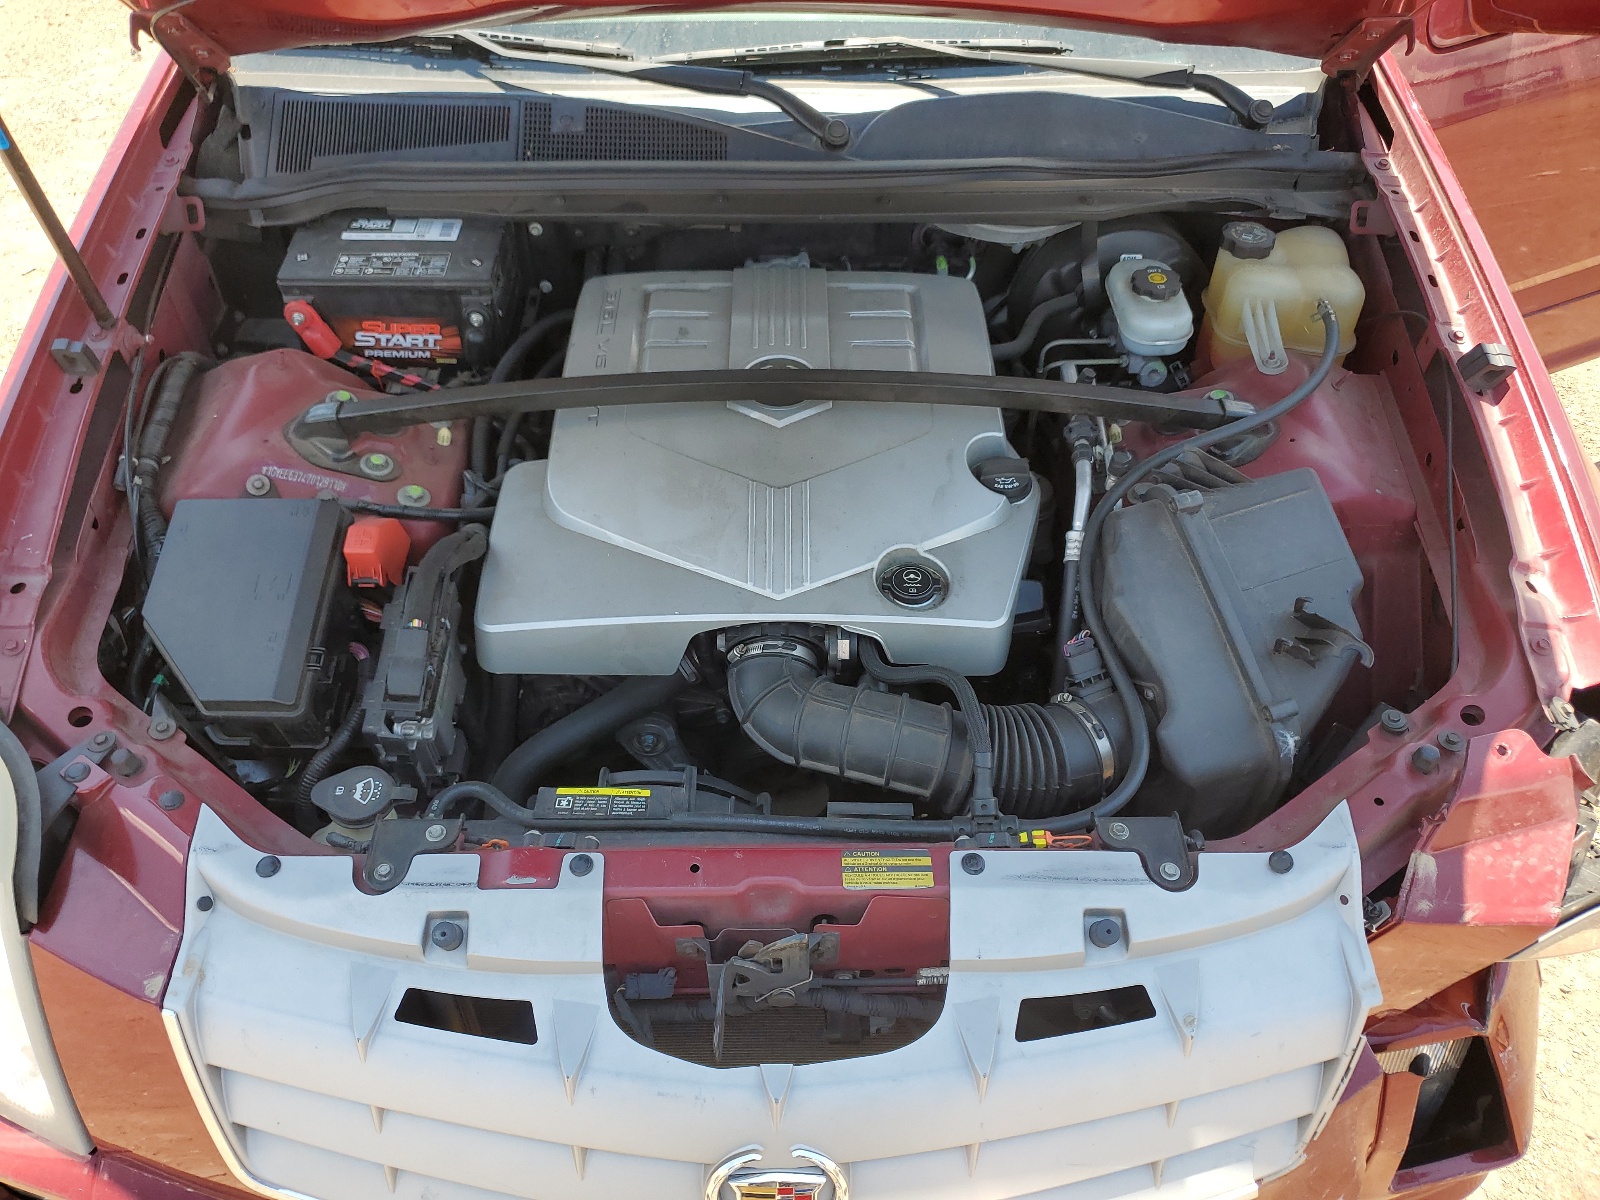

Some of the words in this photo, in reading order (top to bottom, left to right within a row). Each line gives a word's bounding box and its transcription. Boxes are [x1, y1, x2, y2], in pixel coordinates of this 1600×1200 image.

[361, 321, 441, 334] SUPER
[354, 331, 442, 348] START
[364, 349, 431, 359] PREMIUM
